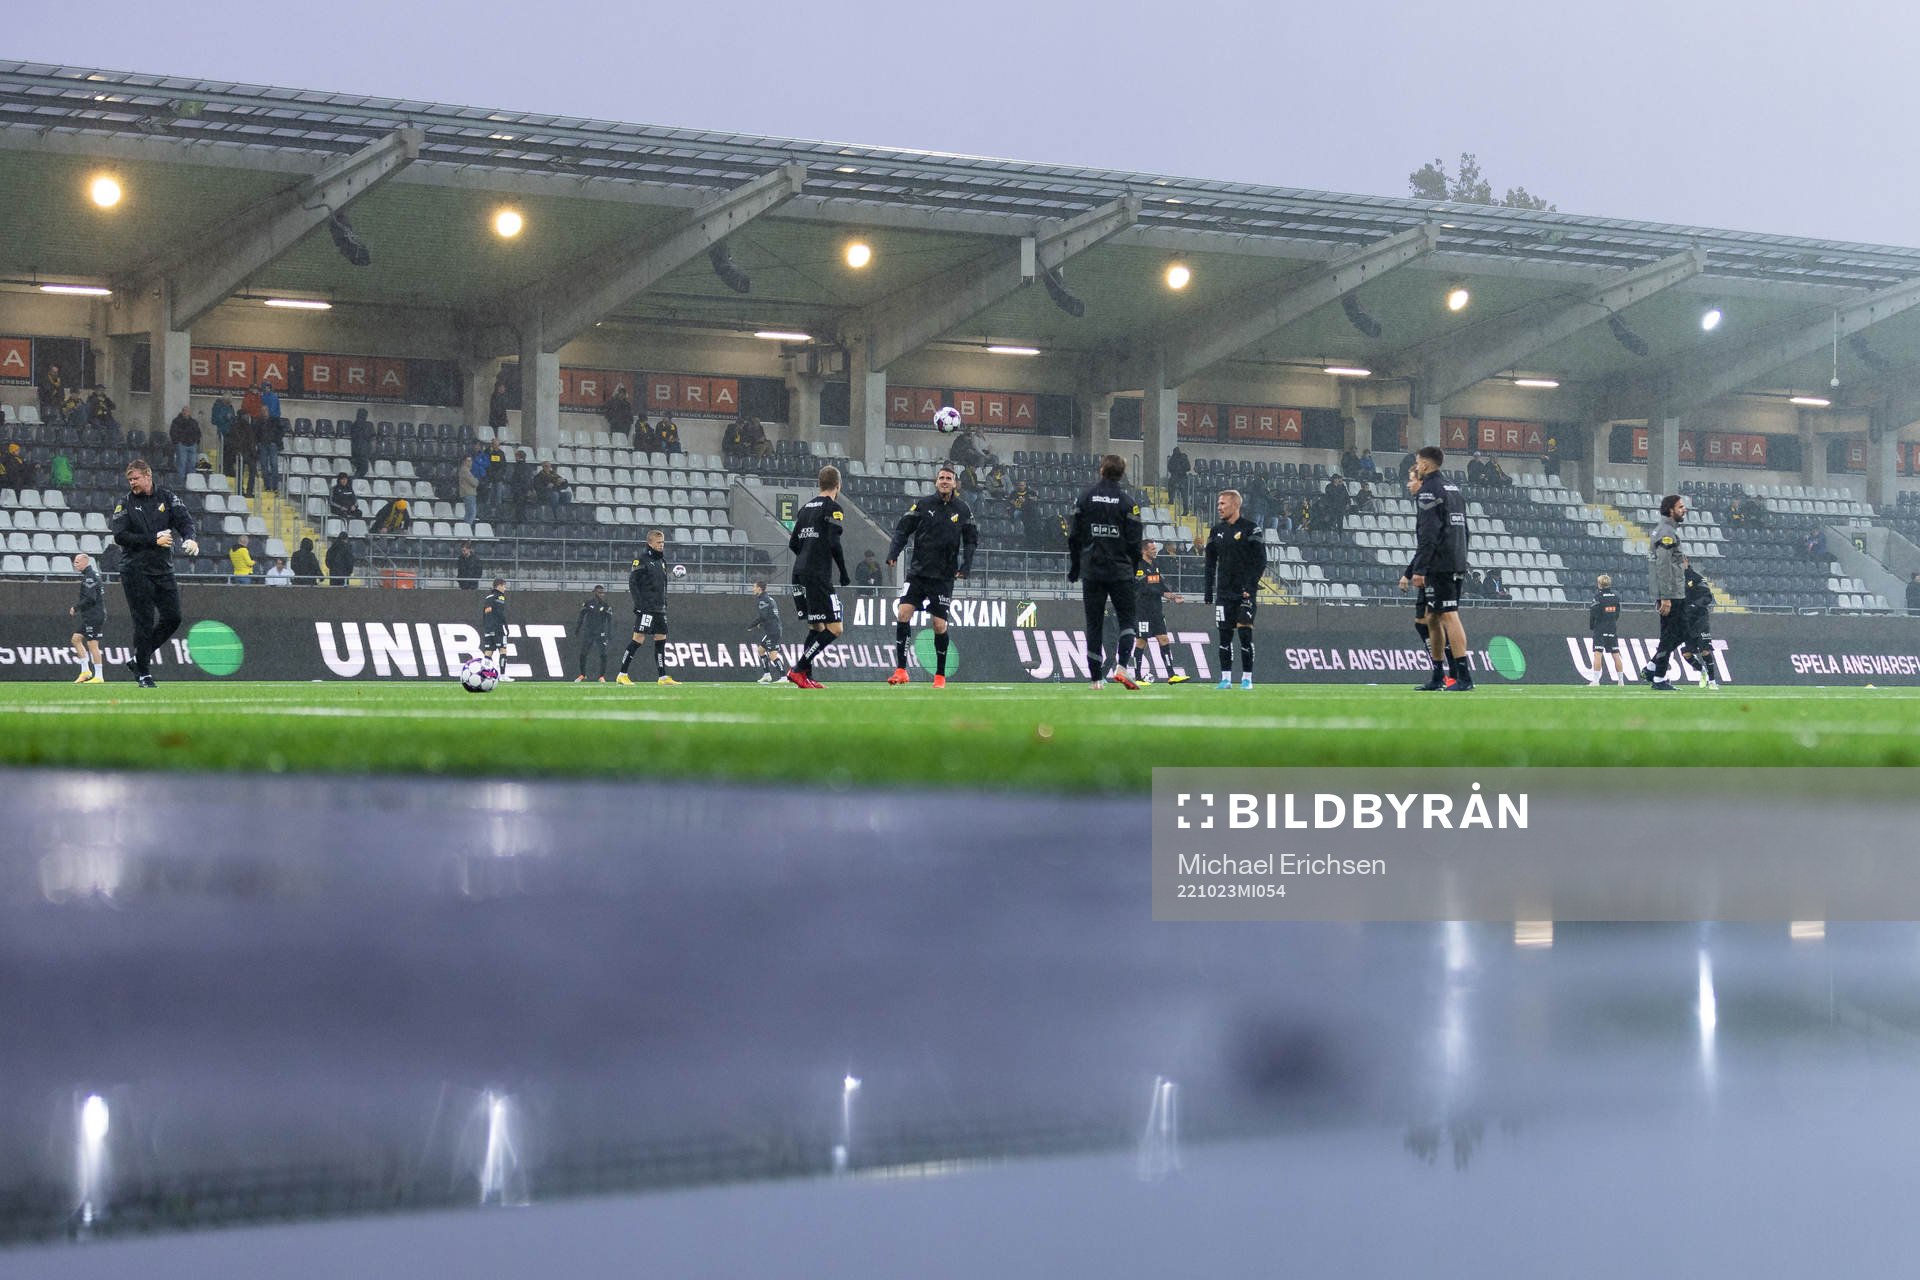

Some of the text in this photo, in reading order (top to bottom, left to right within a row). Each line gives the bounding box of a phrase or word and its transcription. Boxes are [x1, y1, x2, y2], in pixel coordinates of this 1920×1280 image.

[191, 358, 283, 381] BRA
[312, 365, 401, 386] BRA
[655, 383, 734, 404] BRA
[961, 400, 1032, 419] BRA
[1235, 415, 1299, 433] BRA
[1483, 428, 1542, 444] BRA
[1709, 440, 1764, 457] BRA
[781, 502, 793, 520] E
[315, 621, 567, 677] UNIBET
[664, 642, 734, 668] SPELA
[1012, 629, 1212, 680] UNET
[1285, 648, 1346, 671] SPELA
[1790, 654, 1920, 675] SPELA ANSVARSF
